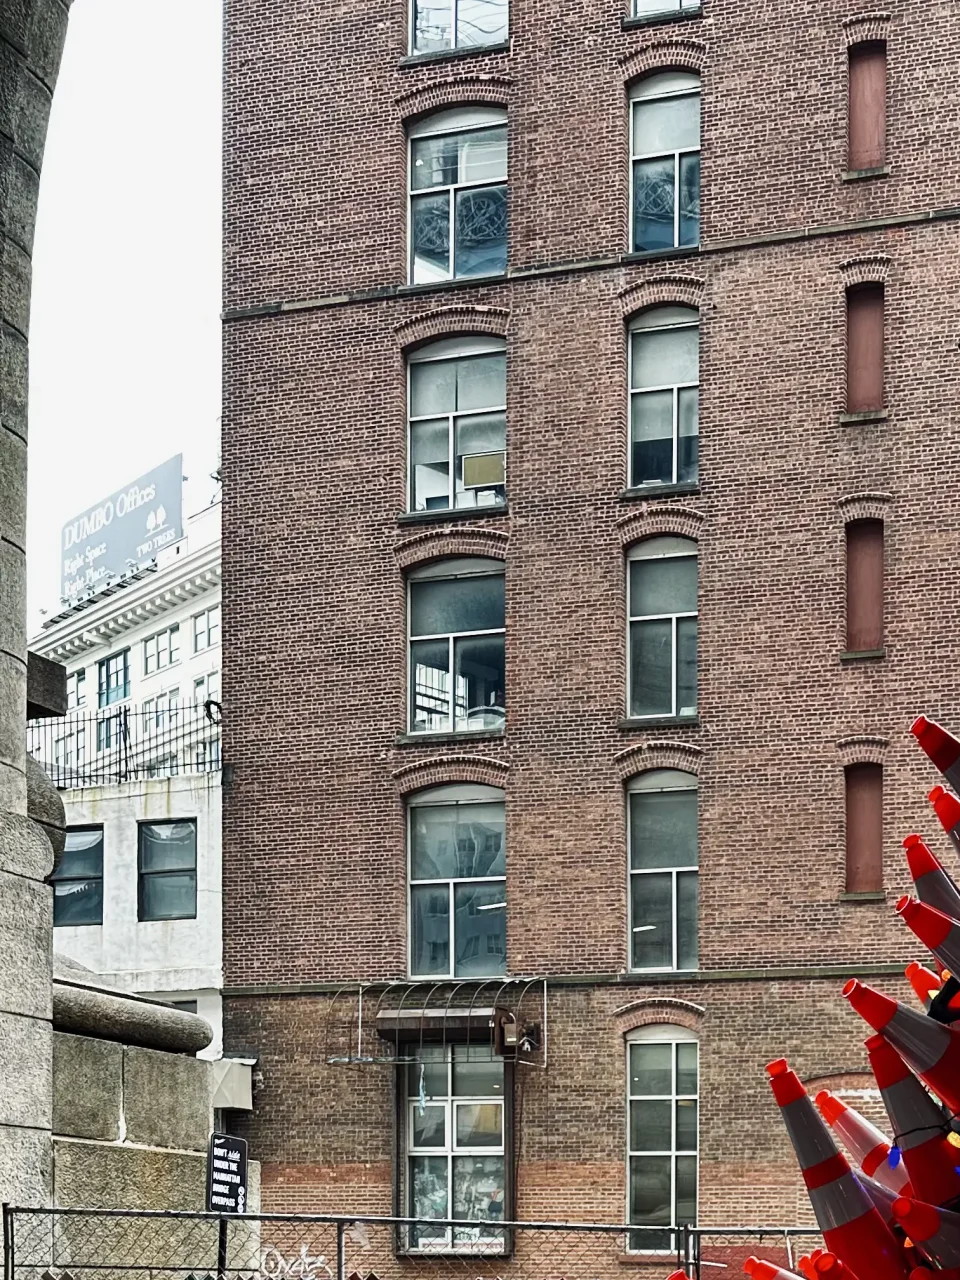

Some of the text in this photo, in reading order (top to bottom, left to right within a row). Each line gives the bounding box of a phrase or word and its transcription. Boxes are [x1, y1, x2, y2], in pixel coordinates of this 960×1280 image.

[64, 483, 156, 551] DUMBO Offices
[136, 528, 176, 558] TWO TREES
[64, 542, 107, 576] Right Space
[64, 566, 106, 599] Right Place
[213, 1159, 239, 1172] UNDER THE
[212, 1171, 241, 1184] MANHATTAN
[212, 1183, 230, 1194] BRIDGE
[211, 1195, 236, 1207] OVERPASS
